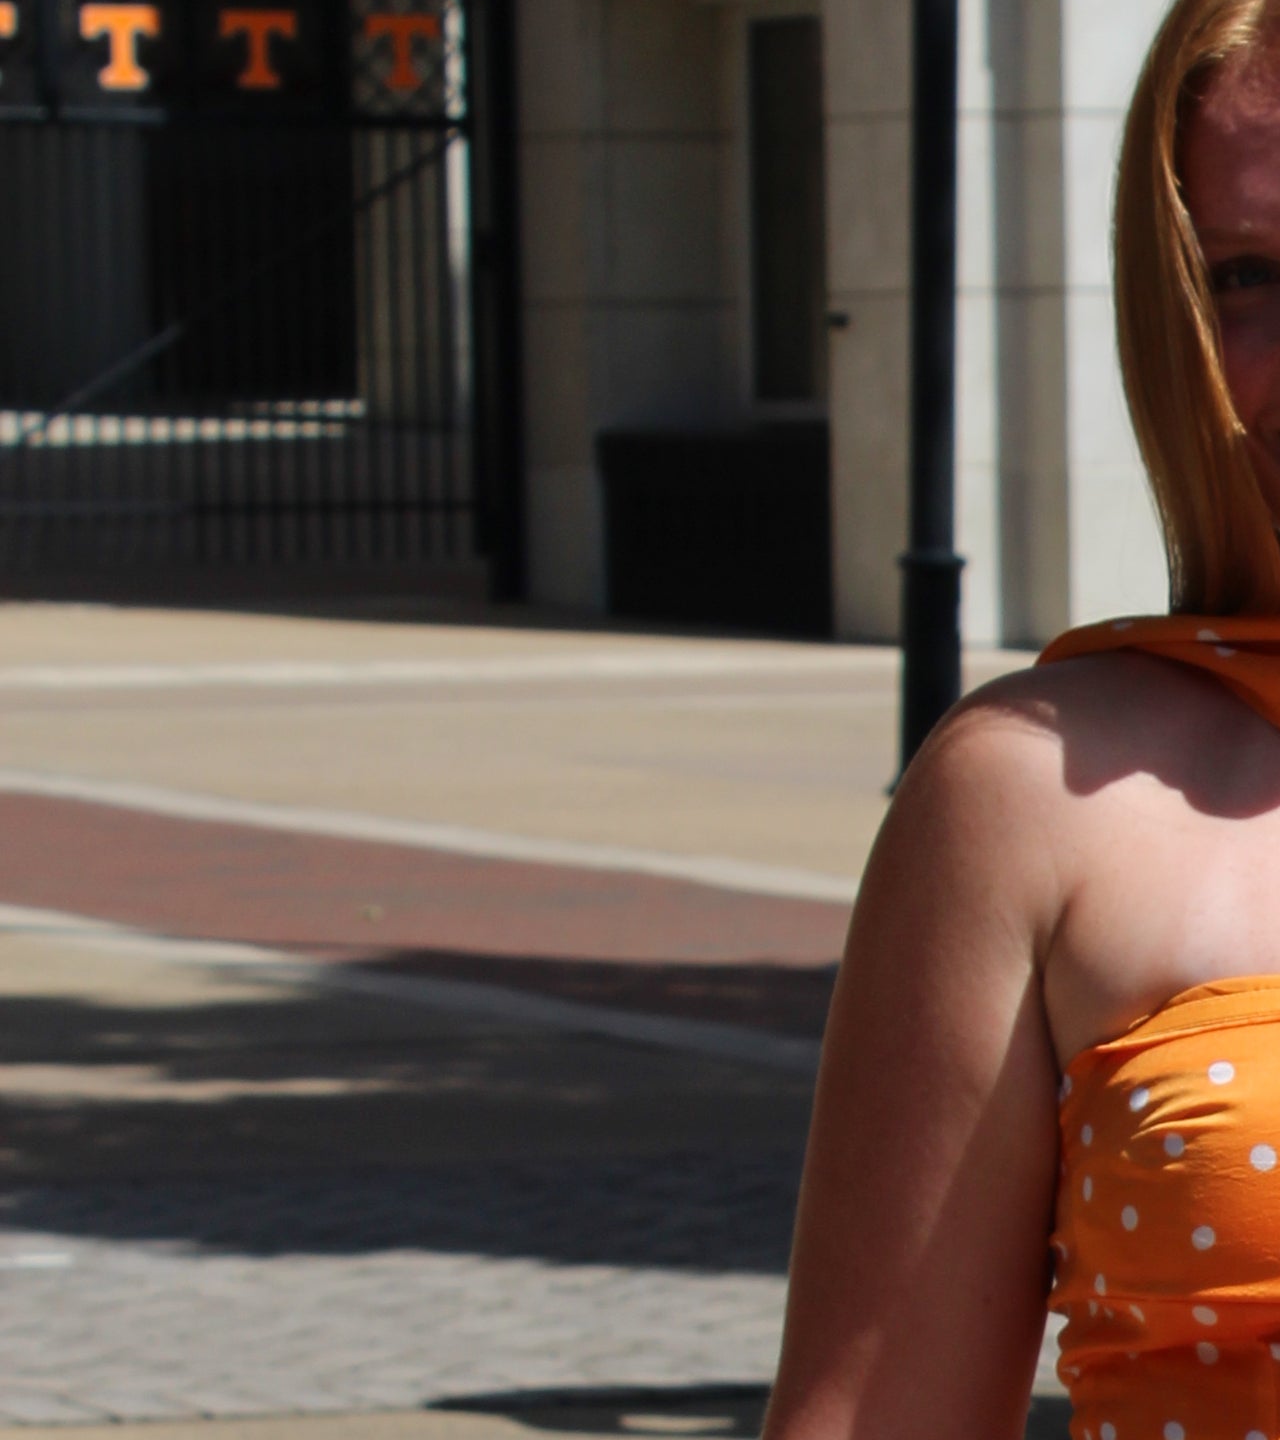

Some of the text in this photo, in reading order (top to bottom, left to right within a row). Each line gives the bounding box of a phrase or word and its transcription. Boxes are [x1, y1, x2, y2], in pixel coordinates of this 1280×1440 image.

[81, 3, 159, 89] T
[219, 9, 296, 89] T
[365, 13, 441, 91] T
